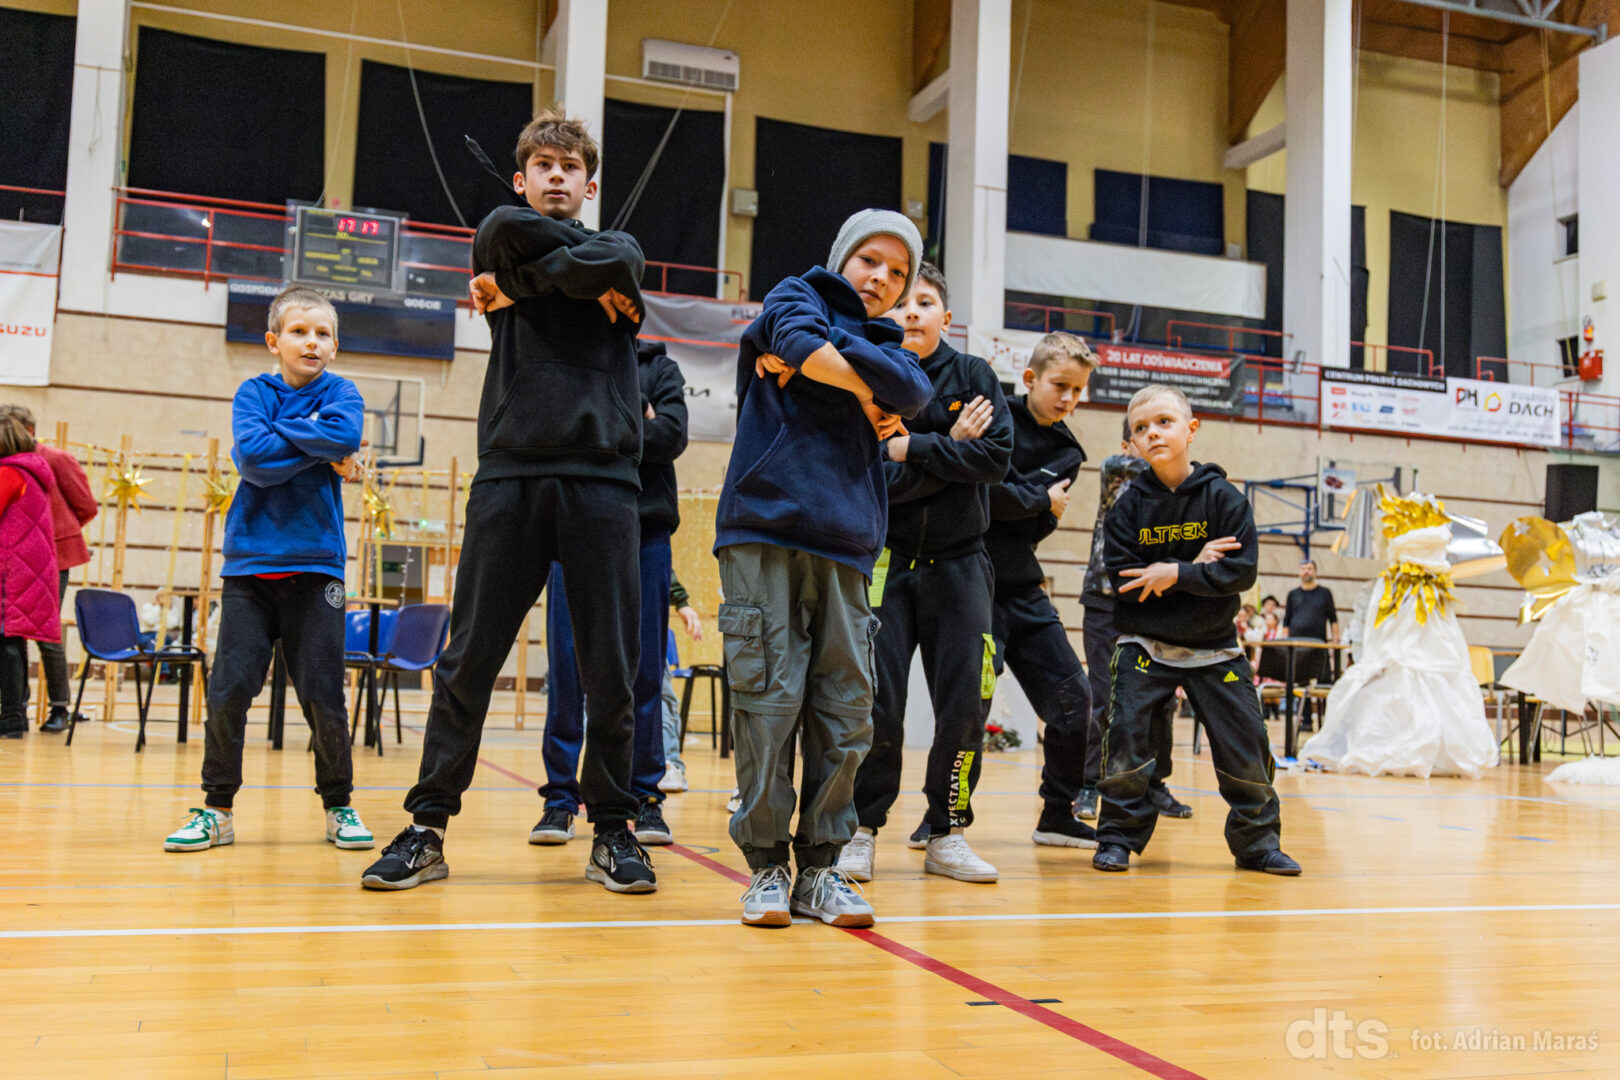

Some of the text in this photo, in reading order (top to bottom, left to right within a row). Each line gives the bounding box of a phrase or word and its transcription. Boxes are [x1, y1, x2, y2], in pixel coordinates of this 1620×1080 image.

[229, 282, 286, 296] GOSPODA
[1122, 352, 1142, 365] LAT
[1508, 401, 1555, 418] DACH
